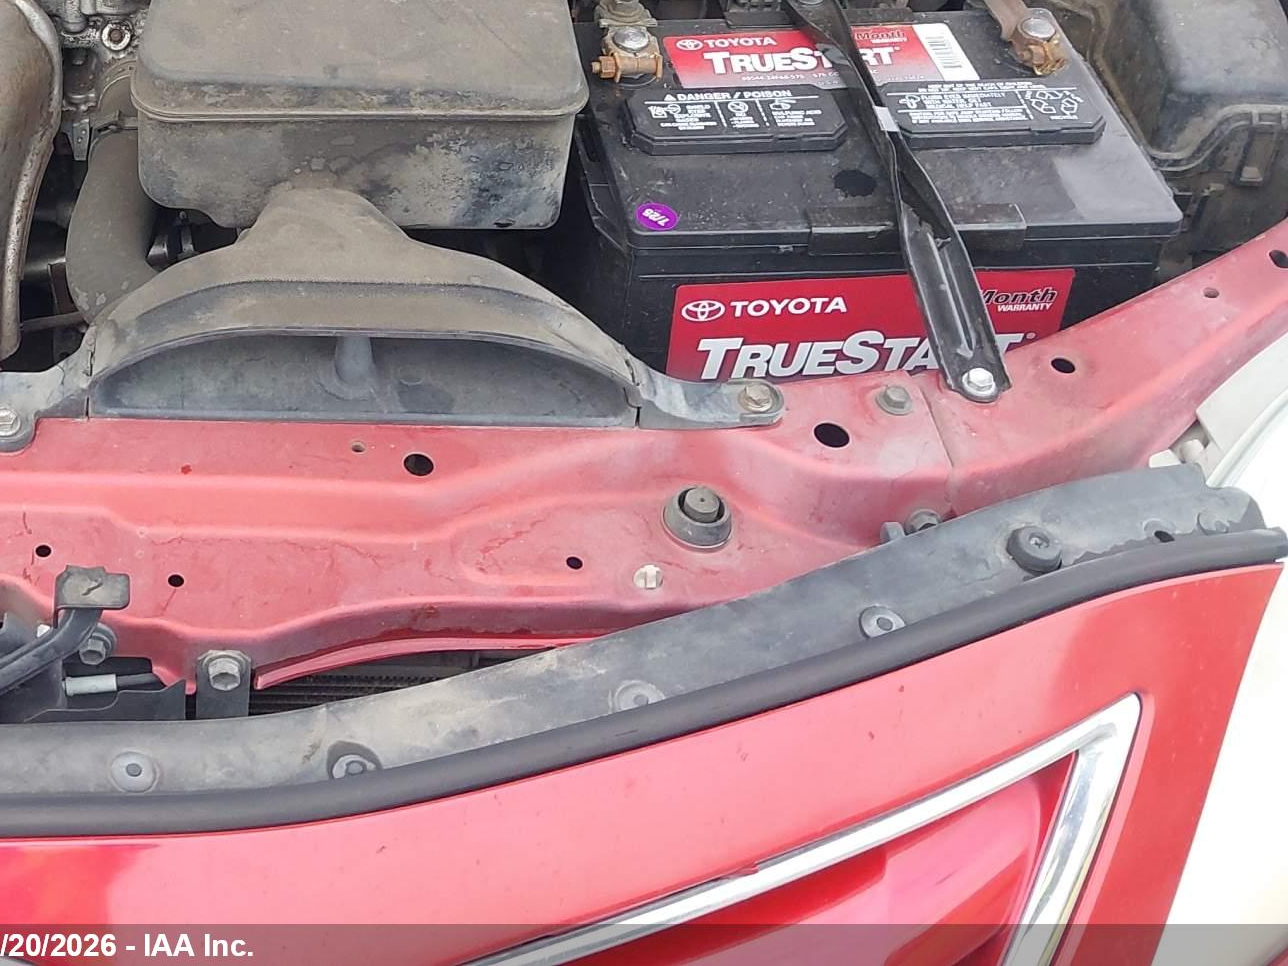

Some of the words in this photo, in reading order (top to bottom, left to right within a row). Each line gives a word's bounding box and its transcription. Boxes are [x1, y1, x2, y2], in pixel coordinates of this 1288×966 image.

[703, 37, 776, 48] TOYOTA
[703, 46, 896, 75] TRUESTRT
[677, 92, 731, 101] DANGER
[743, 89, 792, 99] POISON
[730, 296, 848, 318] TOYOTA
[997, 302, 1053, 313] WARRANTY
[697, 330, 1025, 380] TRUESTAT
